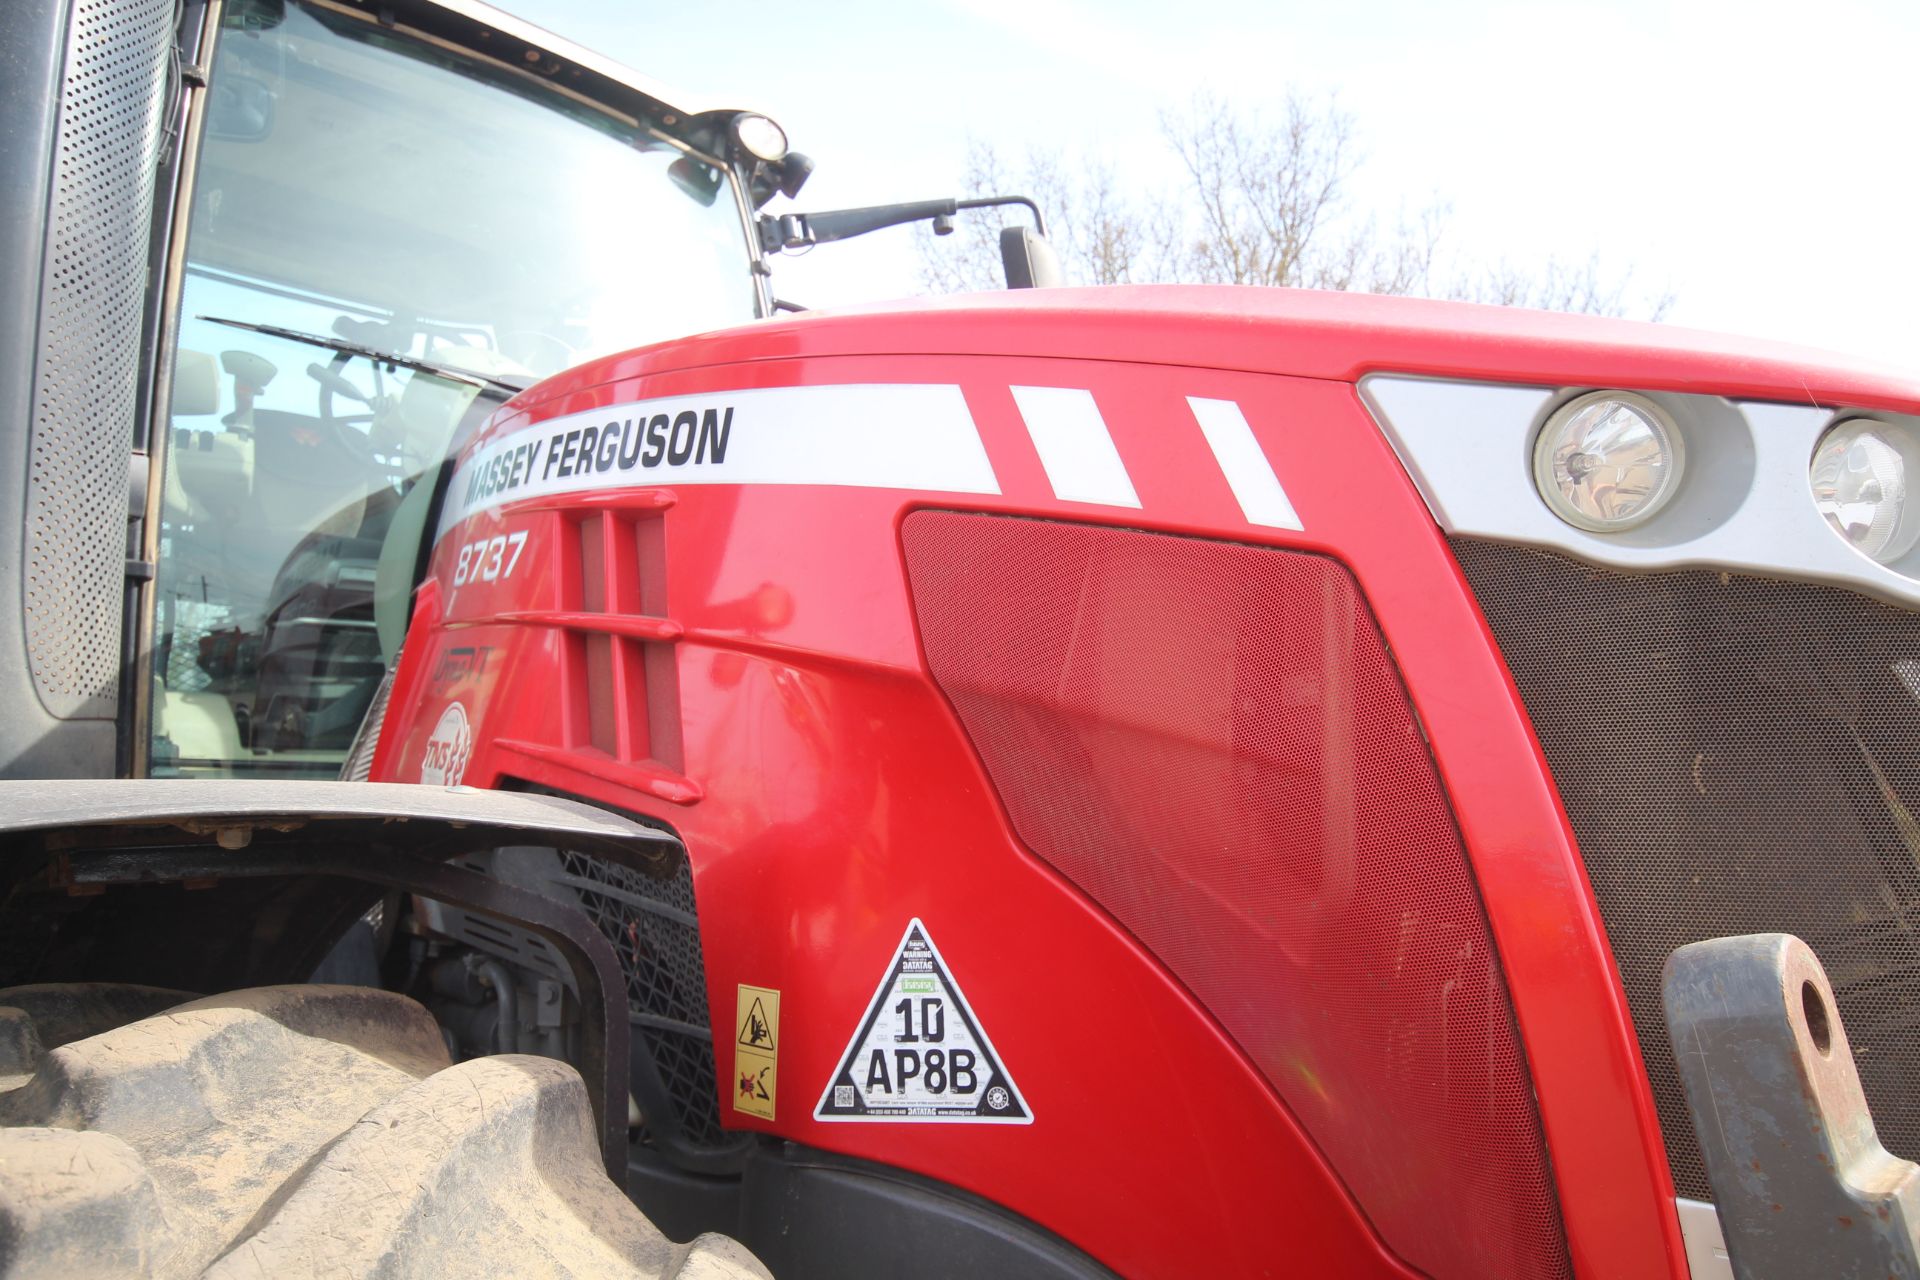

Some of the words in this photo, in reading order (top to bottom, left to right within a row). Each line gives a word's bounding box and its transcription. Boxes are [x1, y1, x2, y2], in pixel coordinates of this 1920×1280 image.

[464, 440, 542, 508] MASSEY
[542, 407, 734, 480] FERGUSON
[454, 530, 529, 588] 8737
[902, 950, 932, 958] WARNING
[902, 961, 933, 970] DATATAG
[865, 1049, 977, 1095] AP8B
